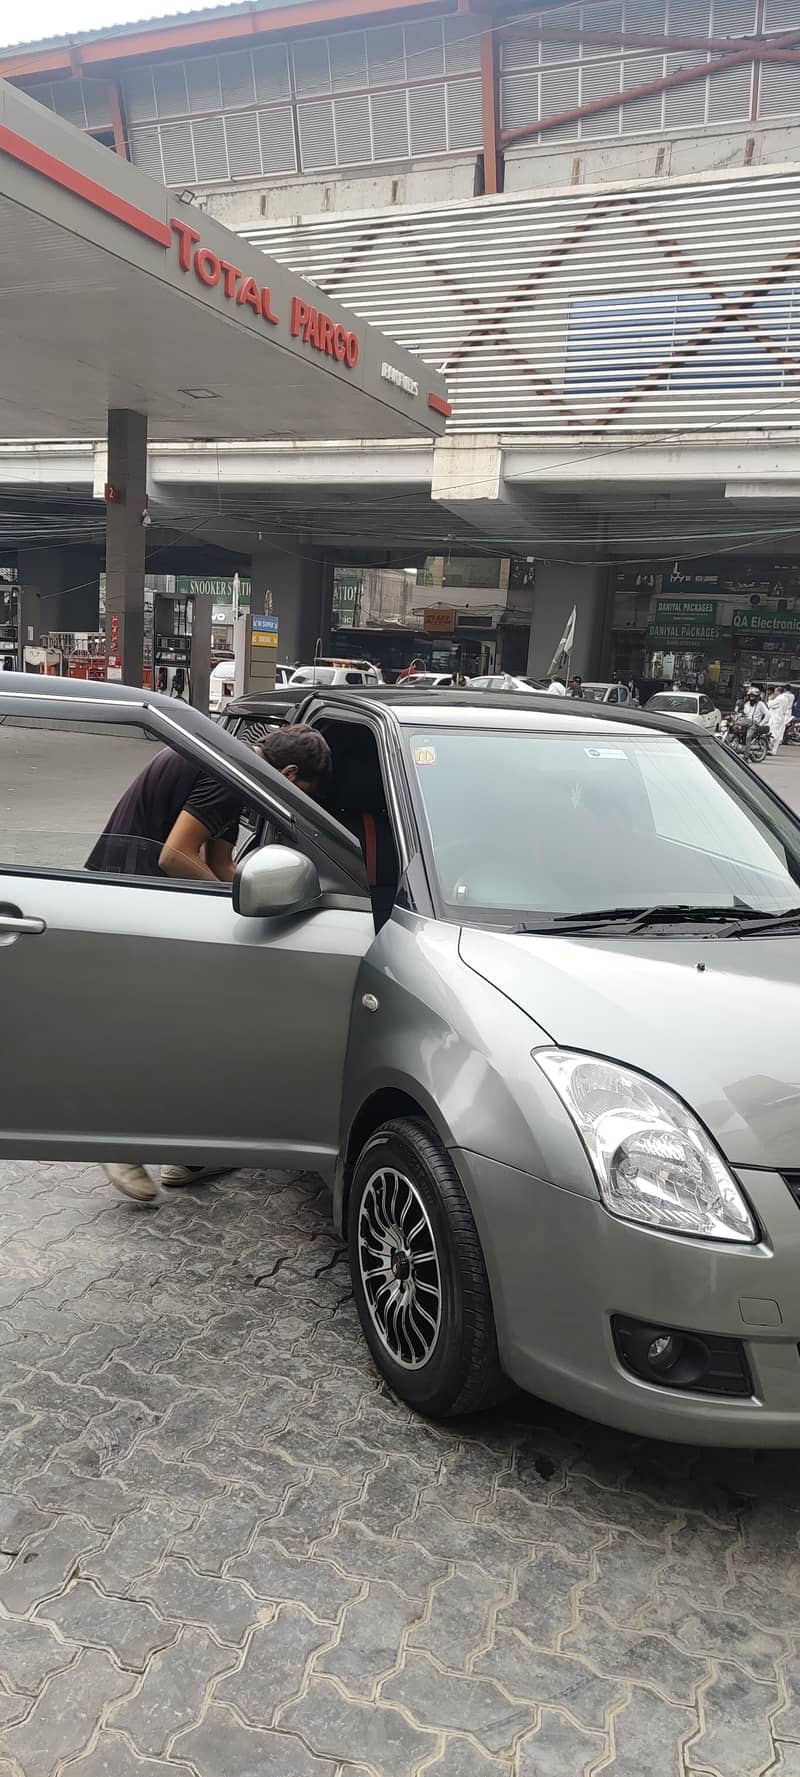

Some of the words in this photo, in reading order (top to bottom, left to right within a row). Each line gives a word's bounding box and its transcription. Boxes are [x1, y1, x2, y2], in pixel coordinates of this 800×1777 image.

[170, 217, 279, 325] TOTAL
[291, 296, 358, 368] PARCO
[108, 487, 114, 498] 2
[190, 580, 226, 595] SNOOKER
[658, 602, 681, 611] DANIYAL
[683, 603, 713, 612] PACKAGES
[733, 615, 748, 627] QA
[649, 625, 680, 636] DANIYAL
[681, 626, 720, 638] PACKAGES
